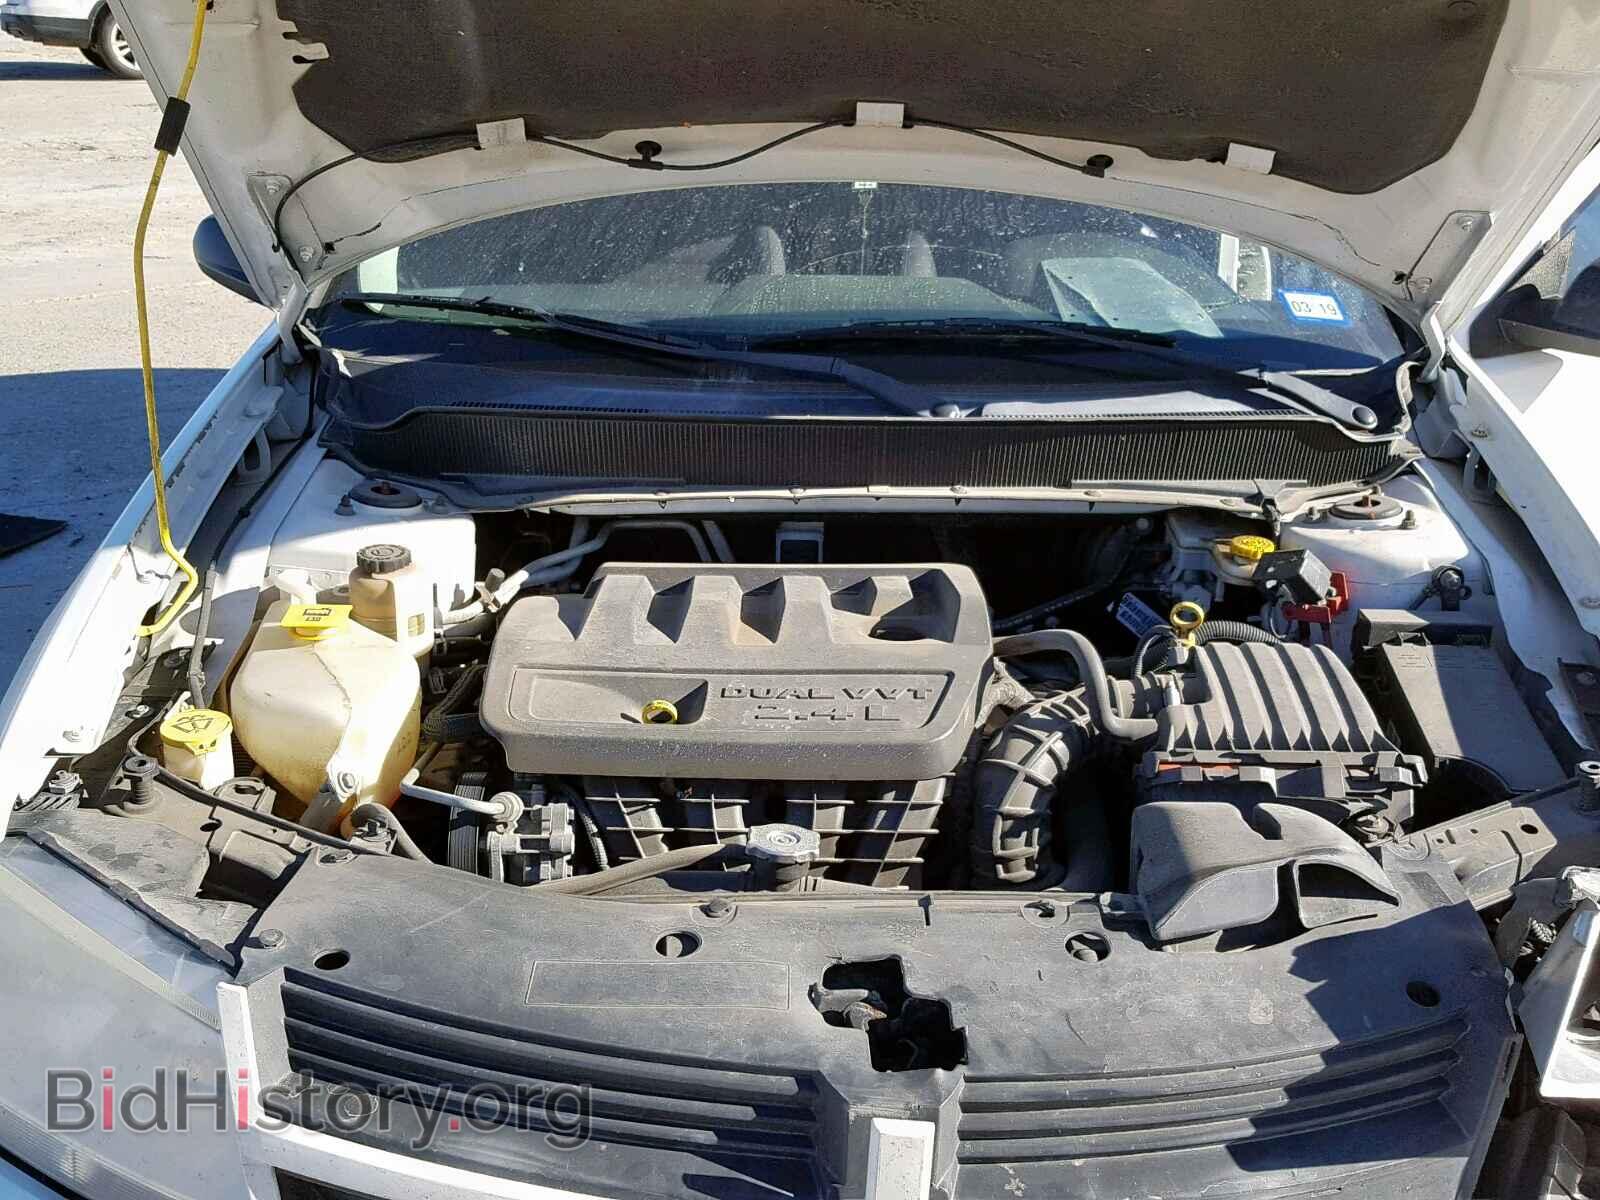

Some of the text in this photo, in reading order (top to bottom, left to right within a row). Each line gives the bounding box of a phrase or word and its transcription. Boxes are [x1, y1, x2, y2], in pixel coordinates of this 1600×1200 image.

[1291, 301, 1312, 313] 03
[719, 686, 933, 700] DUAL VVT
